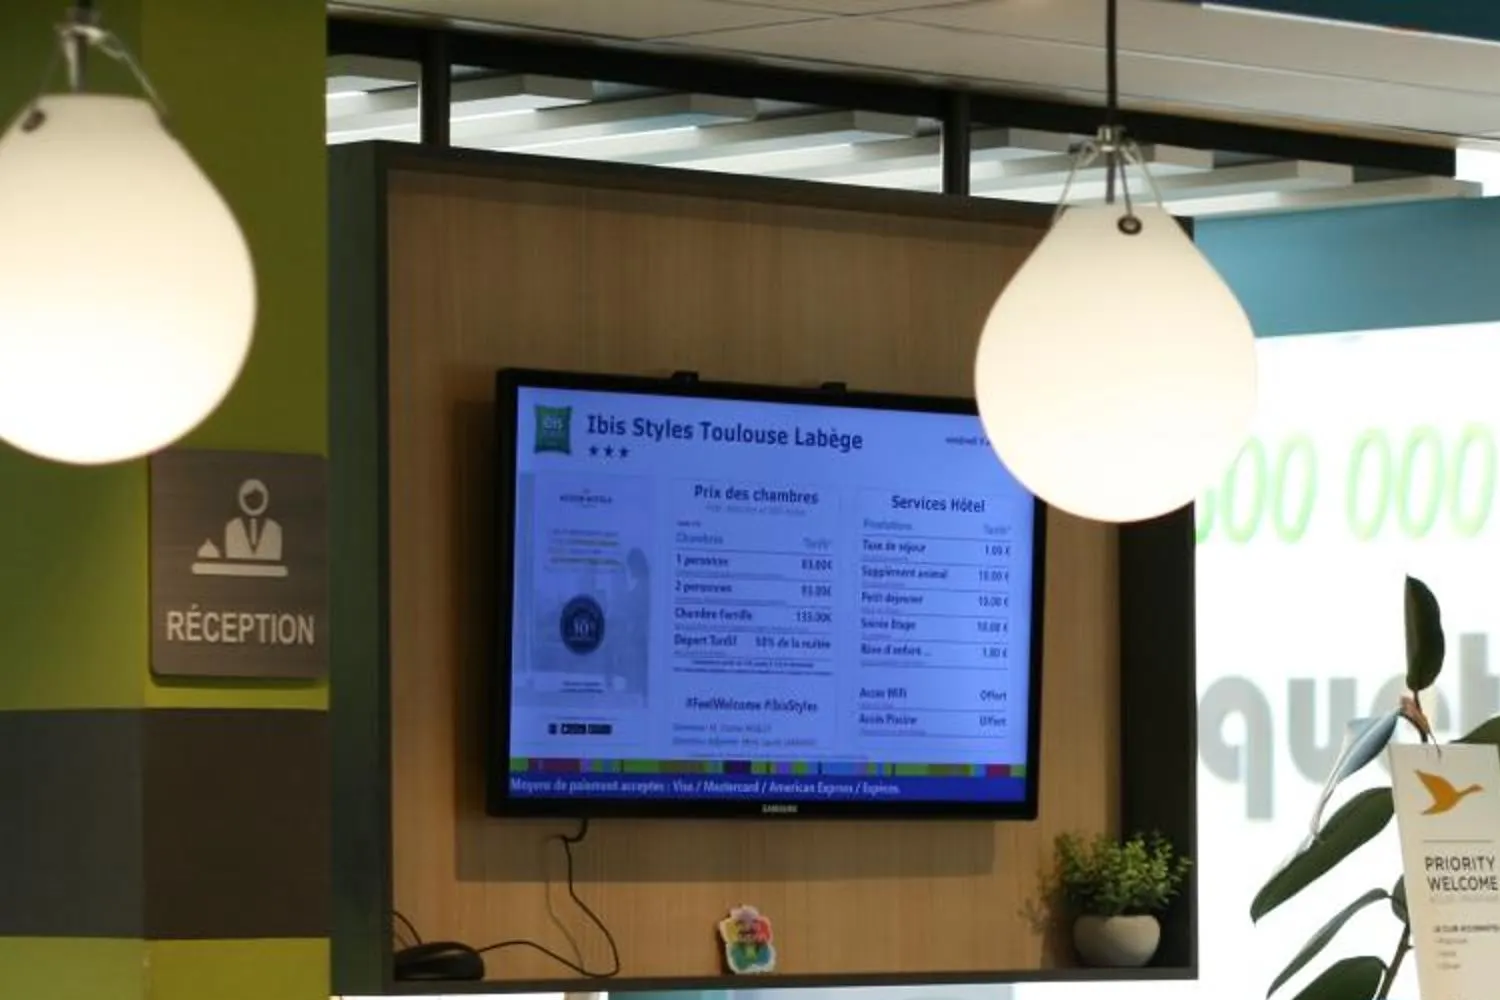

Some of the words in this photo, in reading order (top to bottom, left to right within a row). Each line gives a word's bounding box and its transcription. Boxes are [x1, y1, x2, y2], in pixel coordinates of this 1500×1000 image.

[587, 414, 627, 436] Ibis
[632, 417, 693, 443] Styles
[701, 420, 790, 446] Toulouse
[795, 424, 864, 454] Labège
[1195, 431, 1318, 544] 00
[1346, 421, 1497, 543] 000
[694, 484, 721, 499] Prix
[726, 487, 749, 501] des
[753, 488, 819, 505] chambres
[891, 495, 947, 511] Services
[166, 604, 315, 645] RÉCEPTION
[1424, 855, 1496, 872] PRIORITY
[1427, 875, 1499, 892] WELCOME
